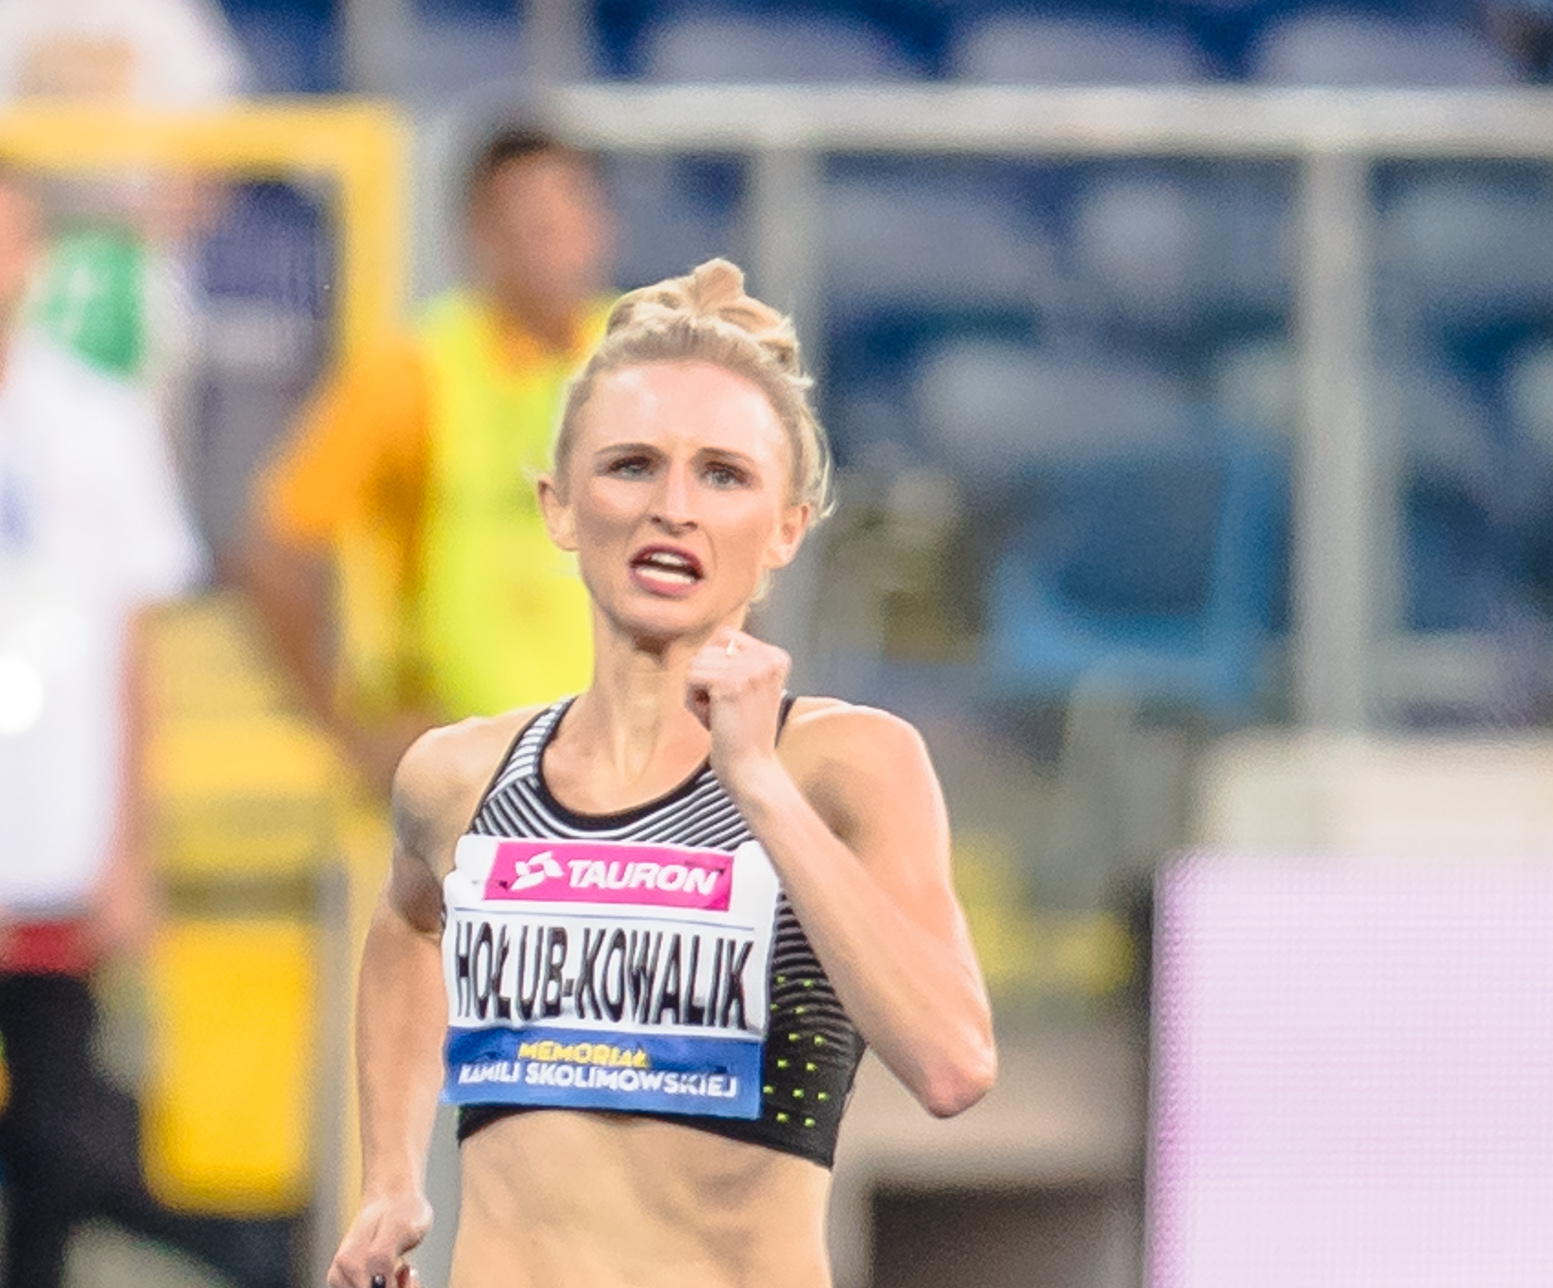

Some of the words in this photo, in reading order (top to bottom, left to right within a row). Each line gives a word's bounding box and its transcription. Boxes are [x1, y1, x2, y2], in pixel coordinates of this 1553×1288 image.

[567, 859, 720, 895] TAURON
[455, 920, 754, 1030] HOŁUB-KOWALIK
[458, 1062, 520, 1085] KAMILI
[525, 1062, 738, 1098] SKOLIMOWSKIEJ
